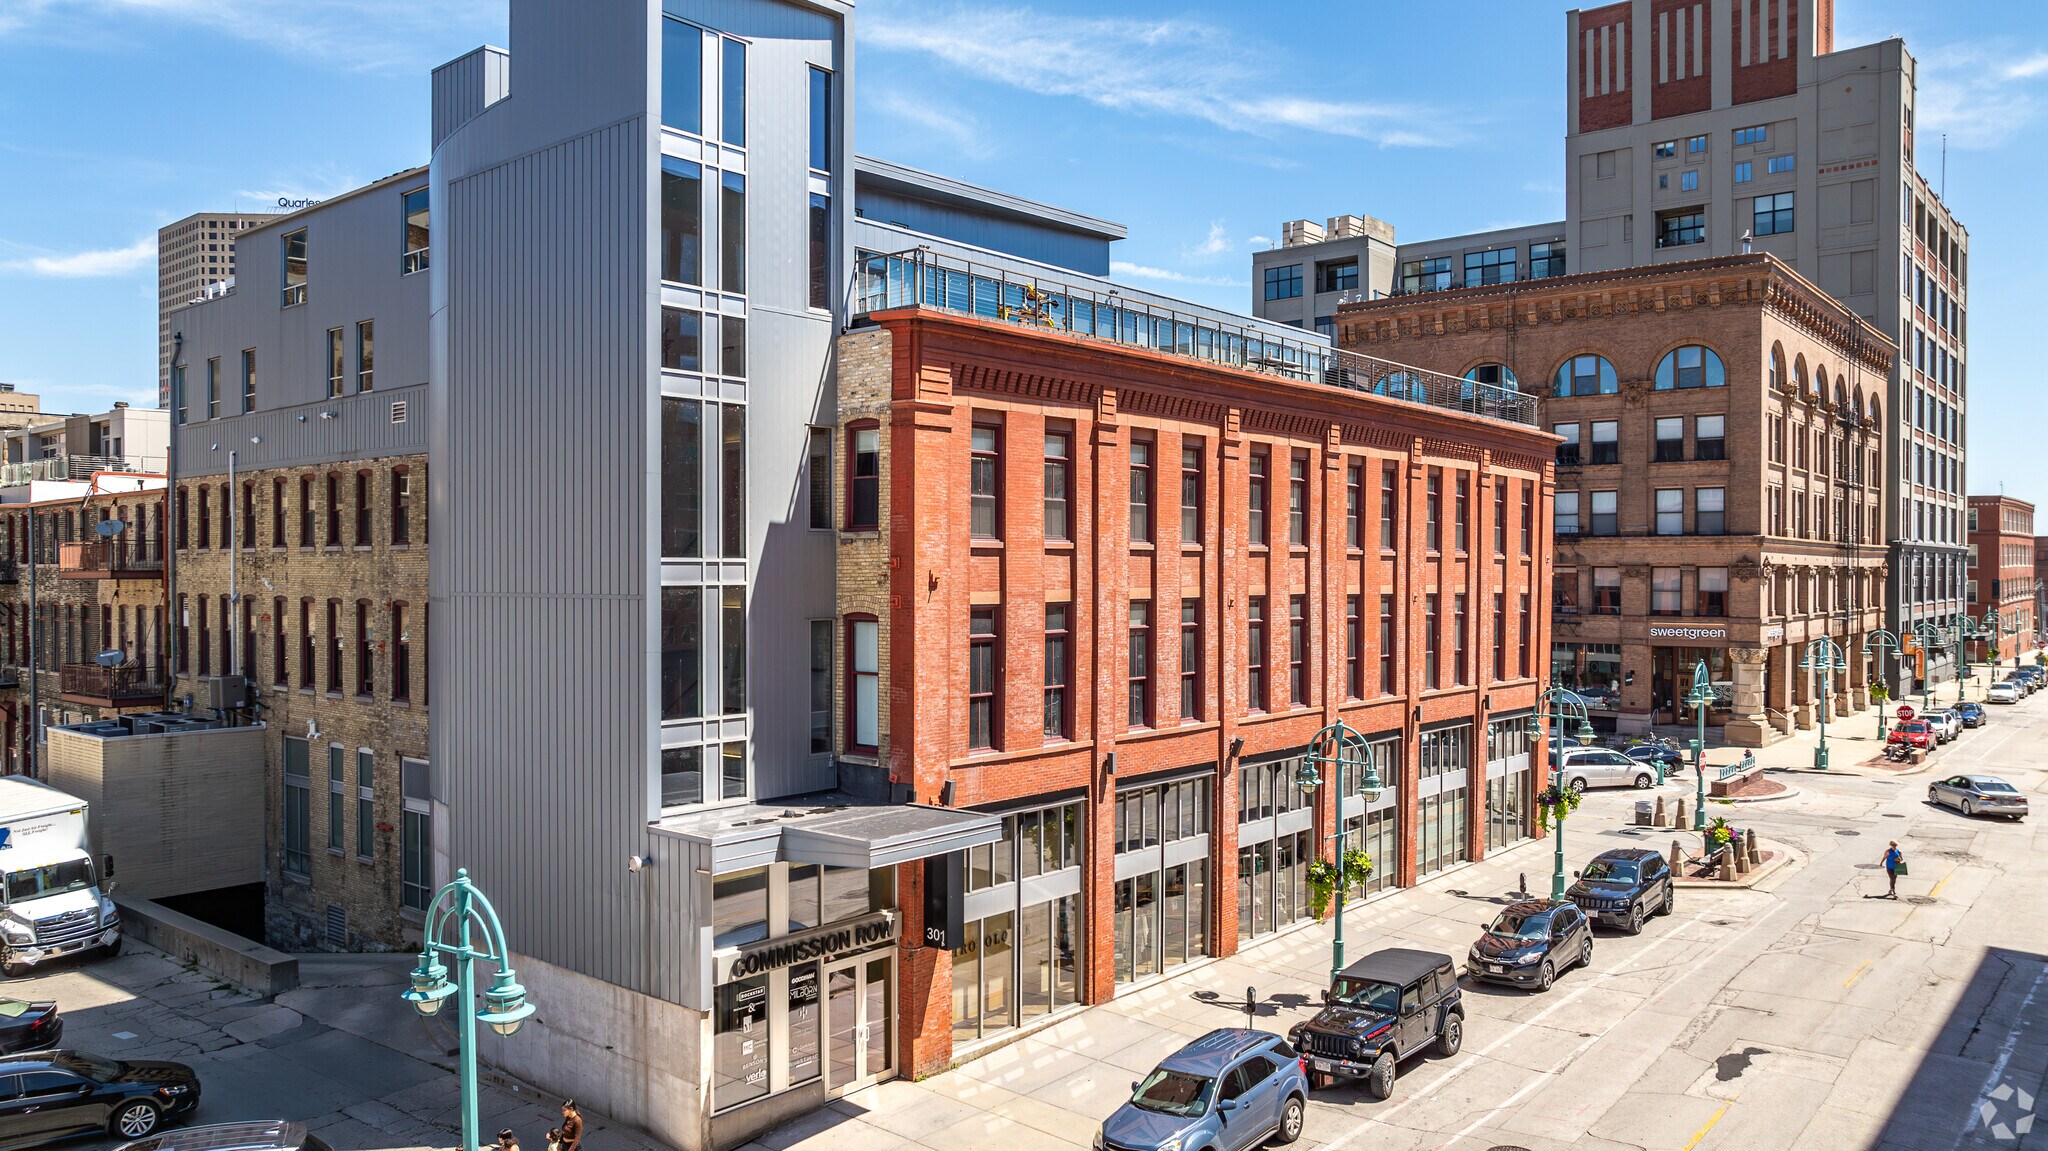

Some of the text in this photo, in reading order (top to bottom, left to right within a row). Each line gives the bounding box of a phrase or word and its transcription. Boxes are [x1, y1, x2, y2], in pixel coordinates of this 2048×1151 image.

[1650, 627, 1726, 639] sweetgreen
[1897, 709, 1914, 717] STOP
[926, 927, 945, 944] 301
[732, 919, 895, 977] COMMISSION ROW
